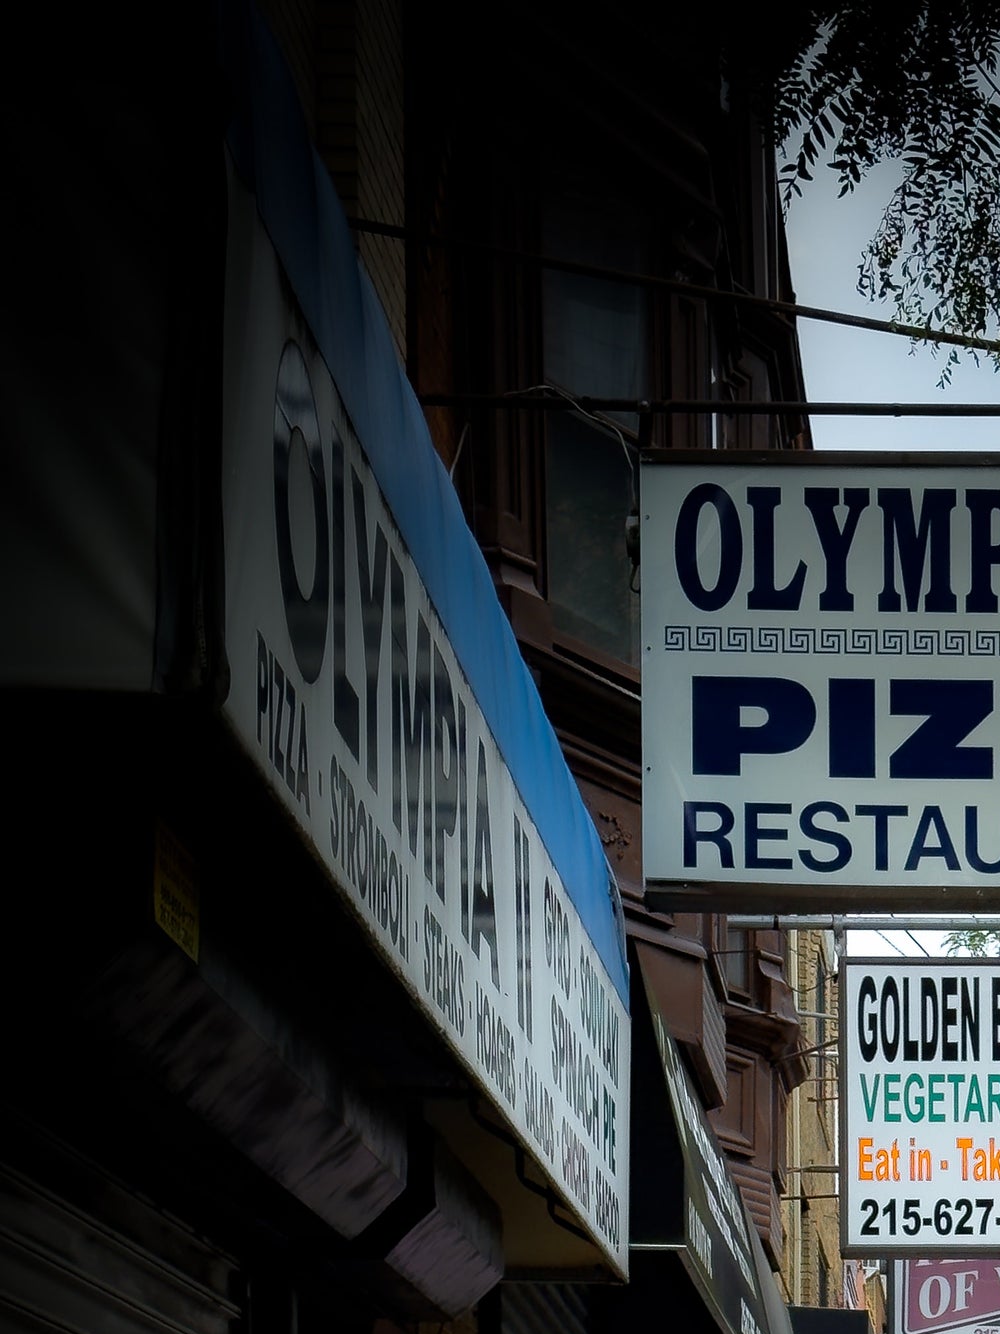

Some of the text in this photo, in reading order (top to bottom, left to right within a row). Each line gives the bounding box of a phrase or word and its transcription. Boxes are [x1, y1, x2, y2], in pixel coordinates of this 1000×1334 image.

[273, 338, 532, 1045] OLYMPIA II
[256, 628, 310, 817] PIZZA
[330, 753, 409, 963] STROMBOLI
[423, 904, 465, 1038] STEAKS
[475, 980, 516, 1110] HOAGIES
[525, 1057, 555, 1165] SALADS
[561, 1115, 590, 1214] CHICKEN
[544, 875, 619, 1090] GYRO SOUVLAKI
[551, 993, 617, 1177] SPINACH PIE
[857, 975, 981, 1063] GOLDEN
[858, 1137, 901, 1182] Eat
[909, 1138, 933, 1181] in
[918, 1270, 980, 1320] OF
